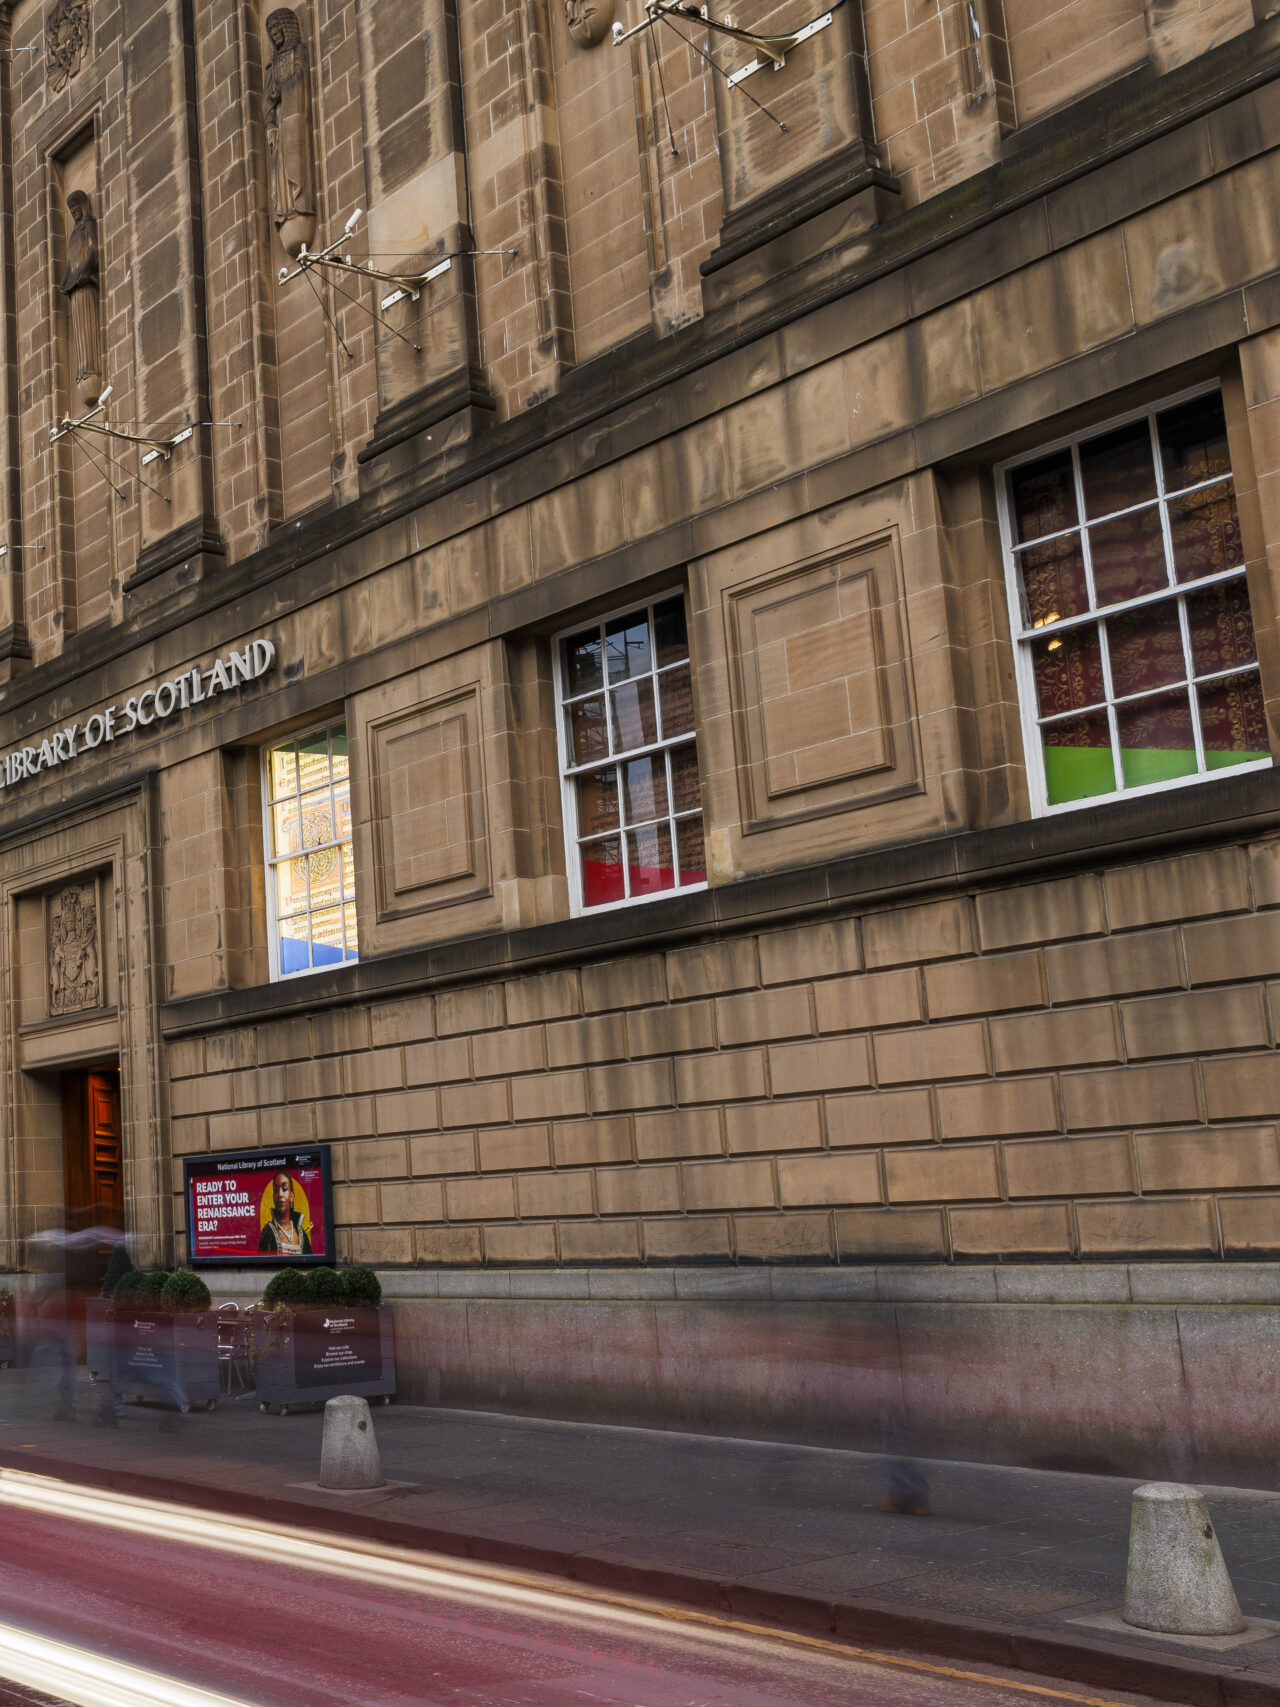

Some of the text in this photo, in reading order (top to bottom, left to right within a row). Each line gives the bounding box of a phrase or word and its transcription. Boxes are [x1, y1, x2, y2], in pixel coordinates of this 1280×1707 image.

[85, 706, 117, 748] OF
[125, 639, 275, 731] SCOTLAND
[217, 1162, 238, 1171] National
[239, 1160, 256, 1170] Library
[263, 1158, 286, 1167] Scotland
[196, 1180, 237, 1193] READY TO
[197, 1192, 249, 1206] ENTER YOUR
[197, 1205, 255, 1219] RENAISSANCE
[198, 1220, 218, 1232] ERA?
